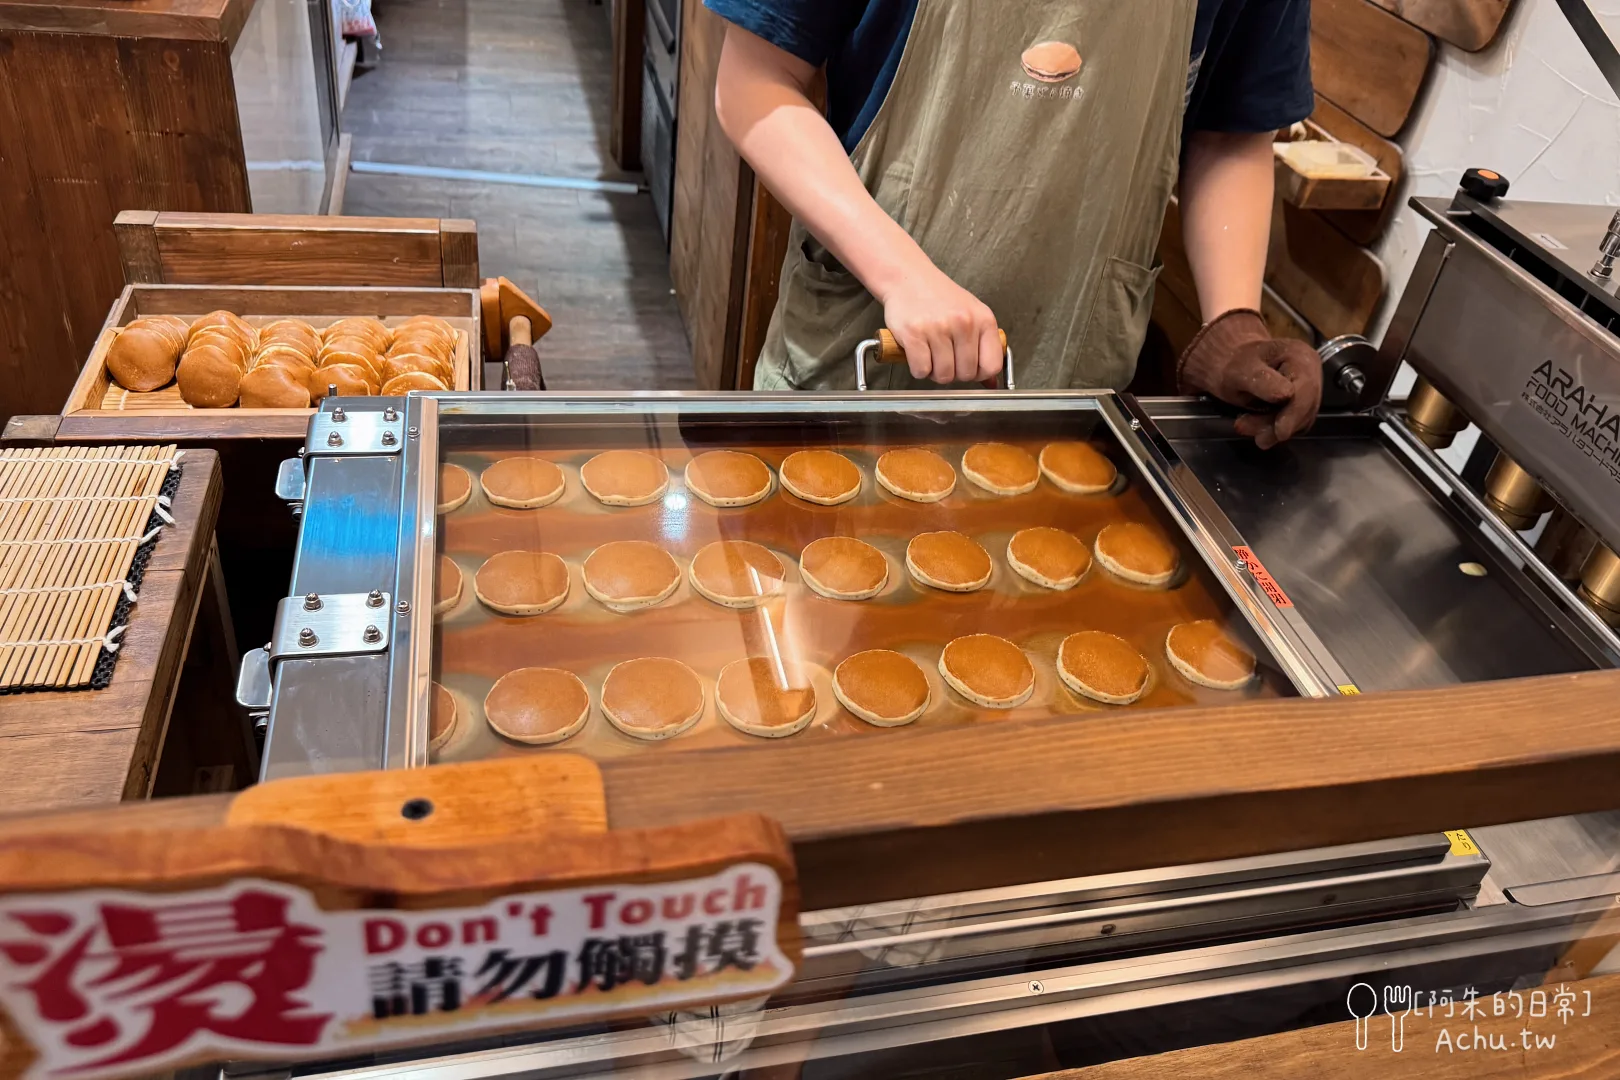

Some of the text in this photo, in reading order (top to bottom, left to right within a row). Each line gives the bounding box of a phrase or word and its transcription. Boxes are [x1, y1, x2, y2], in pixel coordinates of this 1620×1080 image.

[1526, 376, 1568, 416] FOOD
[363, 872, 768, 955] Don't Touch
[367, 917, 765, 1018] 請勿觸摸
